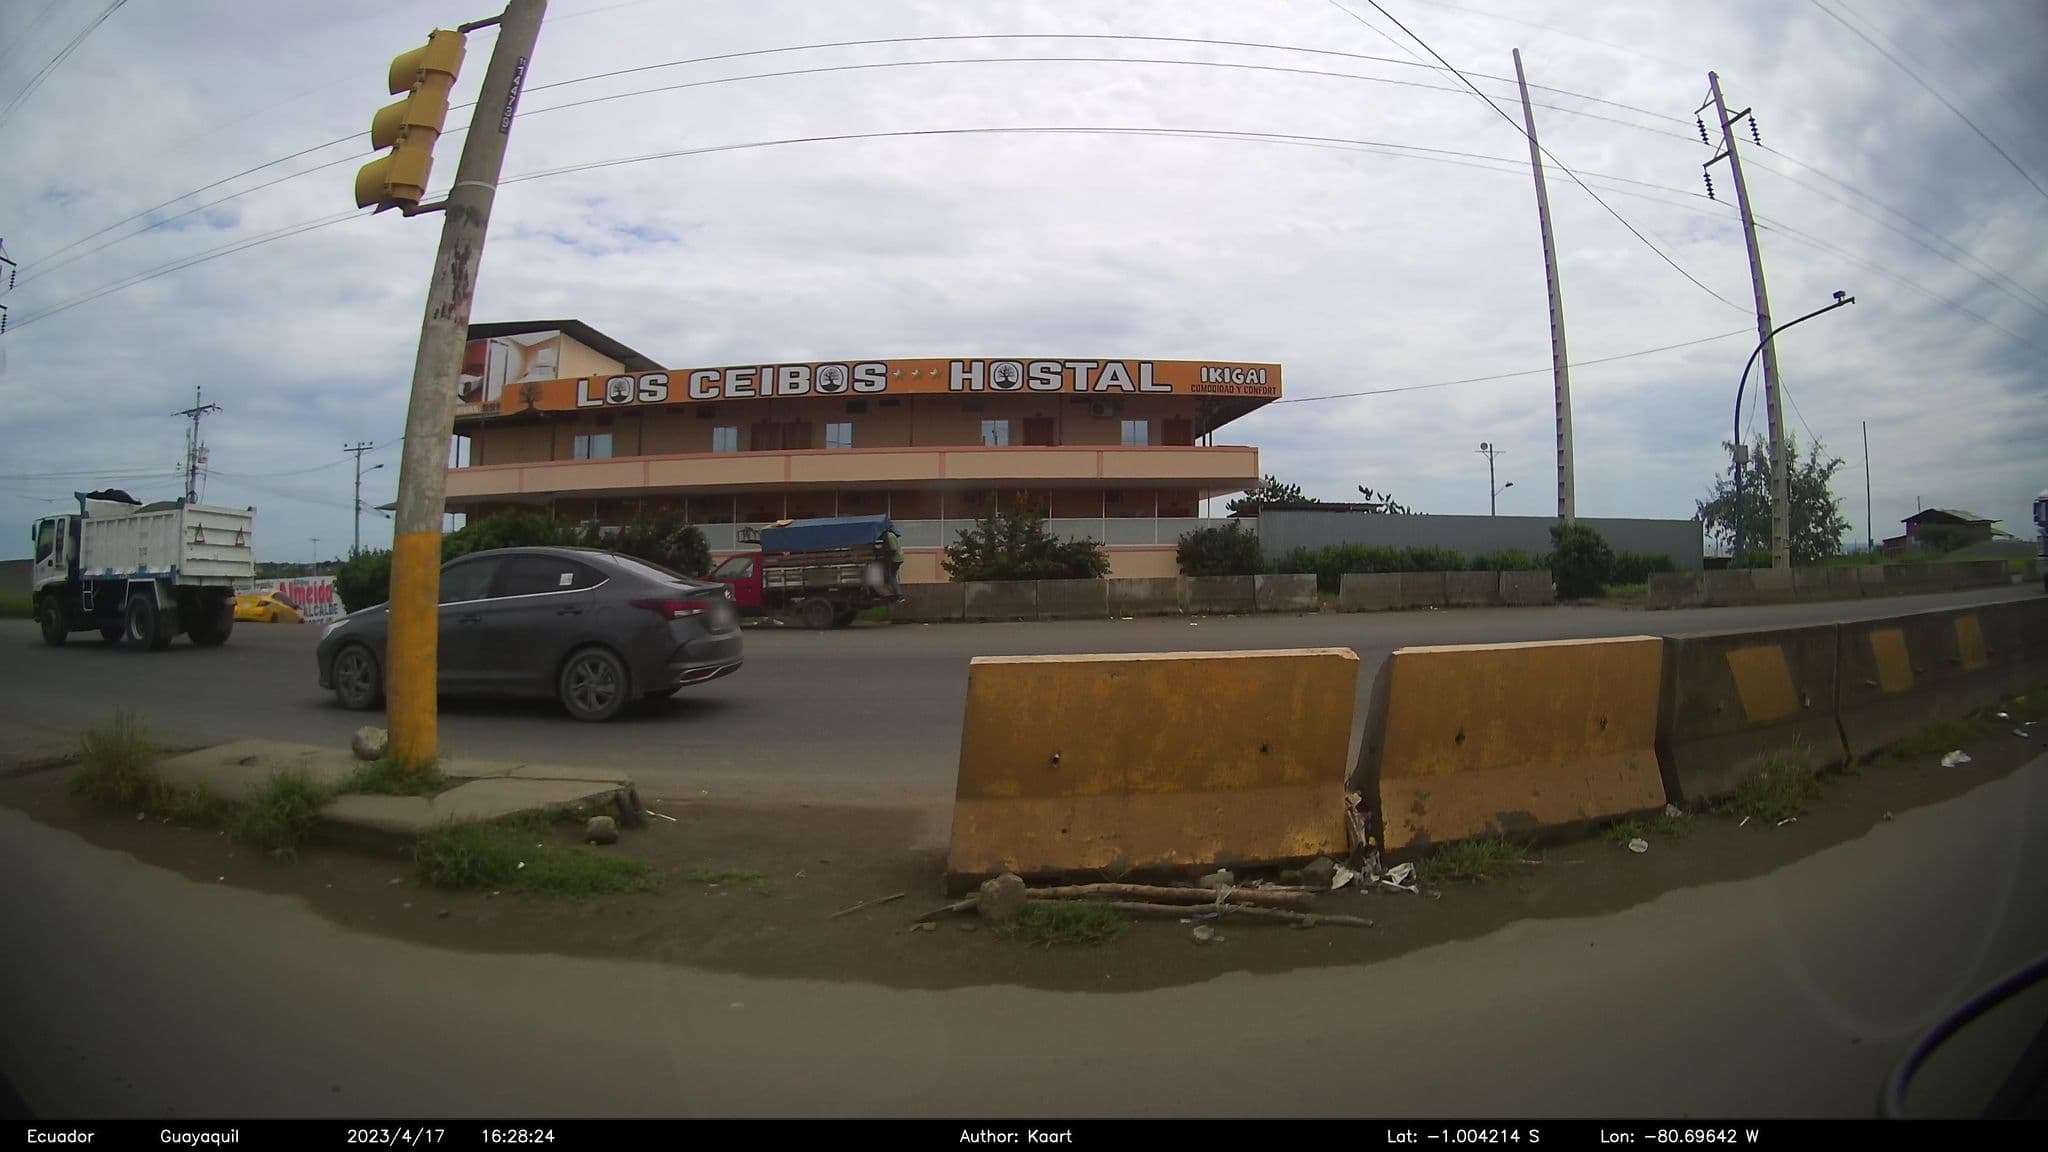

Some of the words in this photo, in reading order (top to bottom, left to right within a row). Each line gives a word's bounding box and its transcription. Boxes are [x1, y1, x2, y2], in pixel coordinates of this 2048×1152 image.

[577, 372, 669, 408] LOS
[688, 361, 887, 400] CEIBOS
[949, 360, 1173, 393] HOSTAL
[1201, 366, 1267, 385] IKIGAI
[1243, 386, 1276, 395] CONFORT
[279, 580, 333, 604] Almeida
[303, 603, 338, 617] ALCALDE
